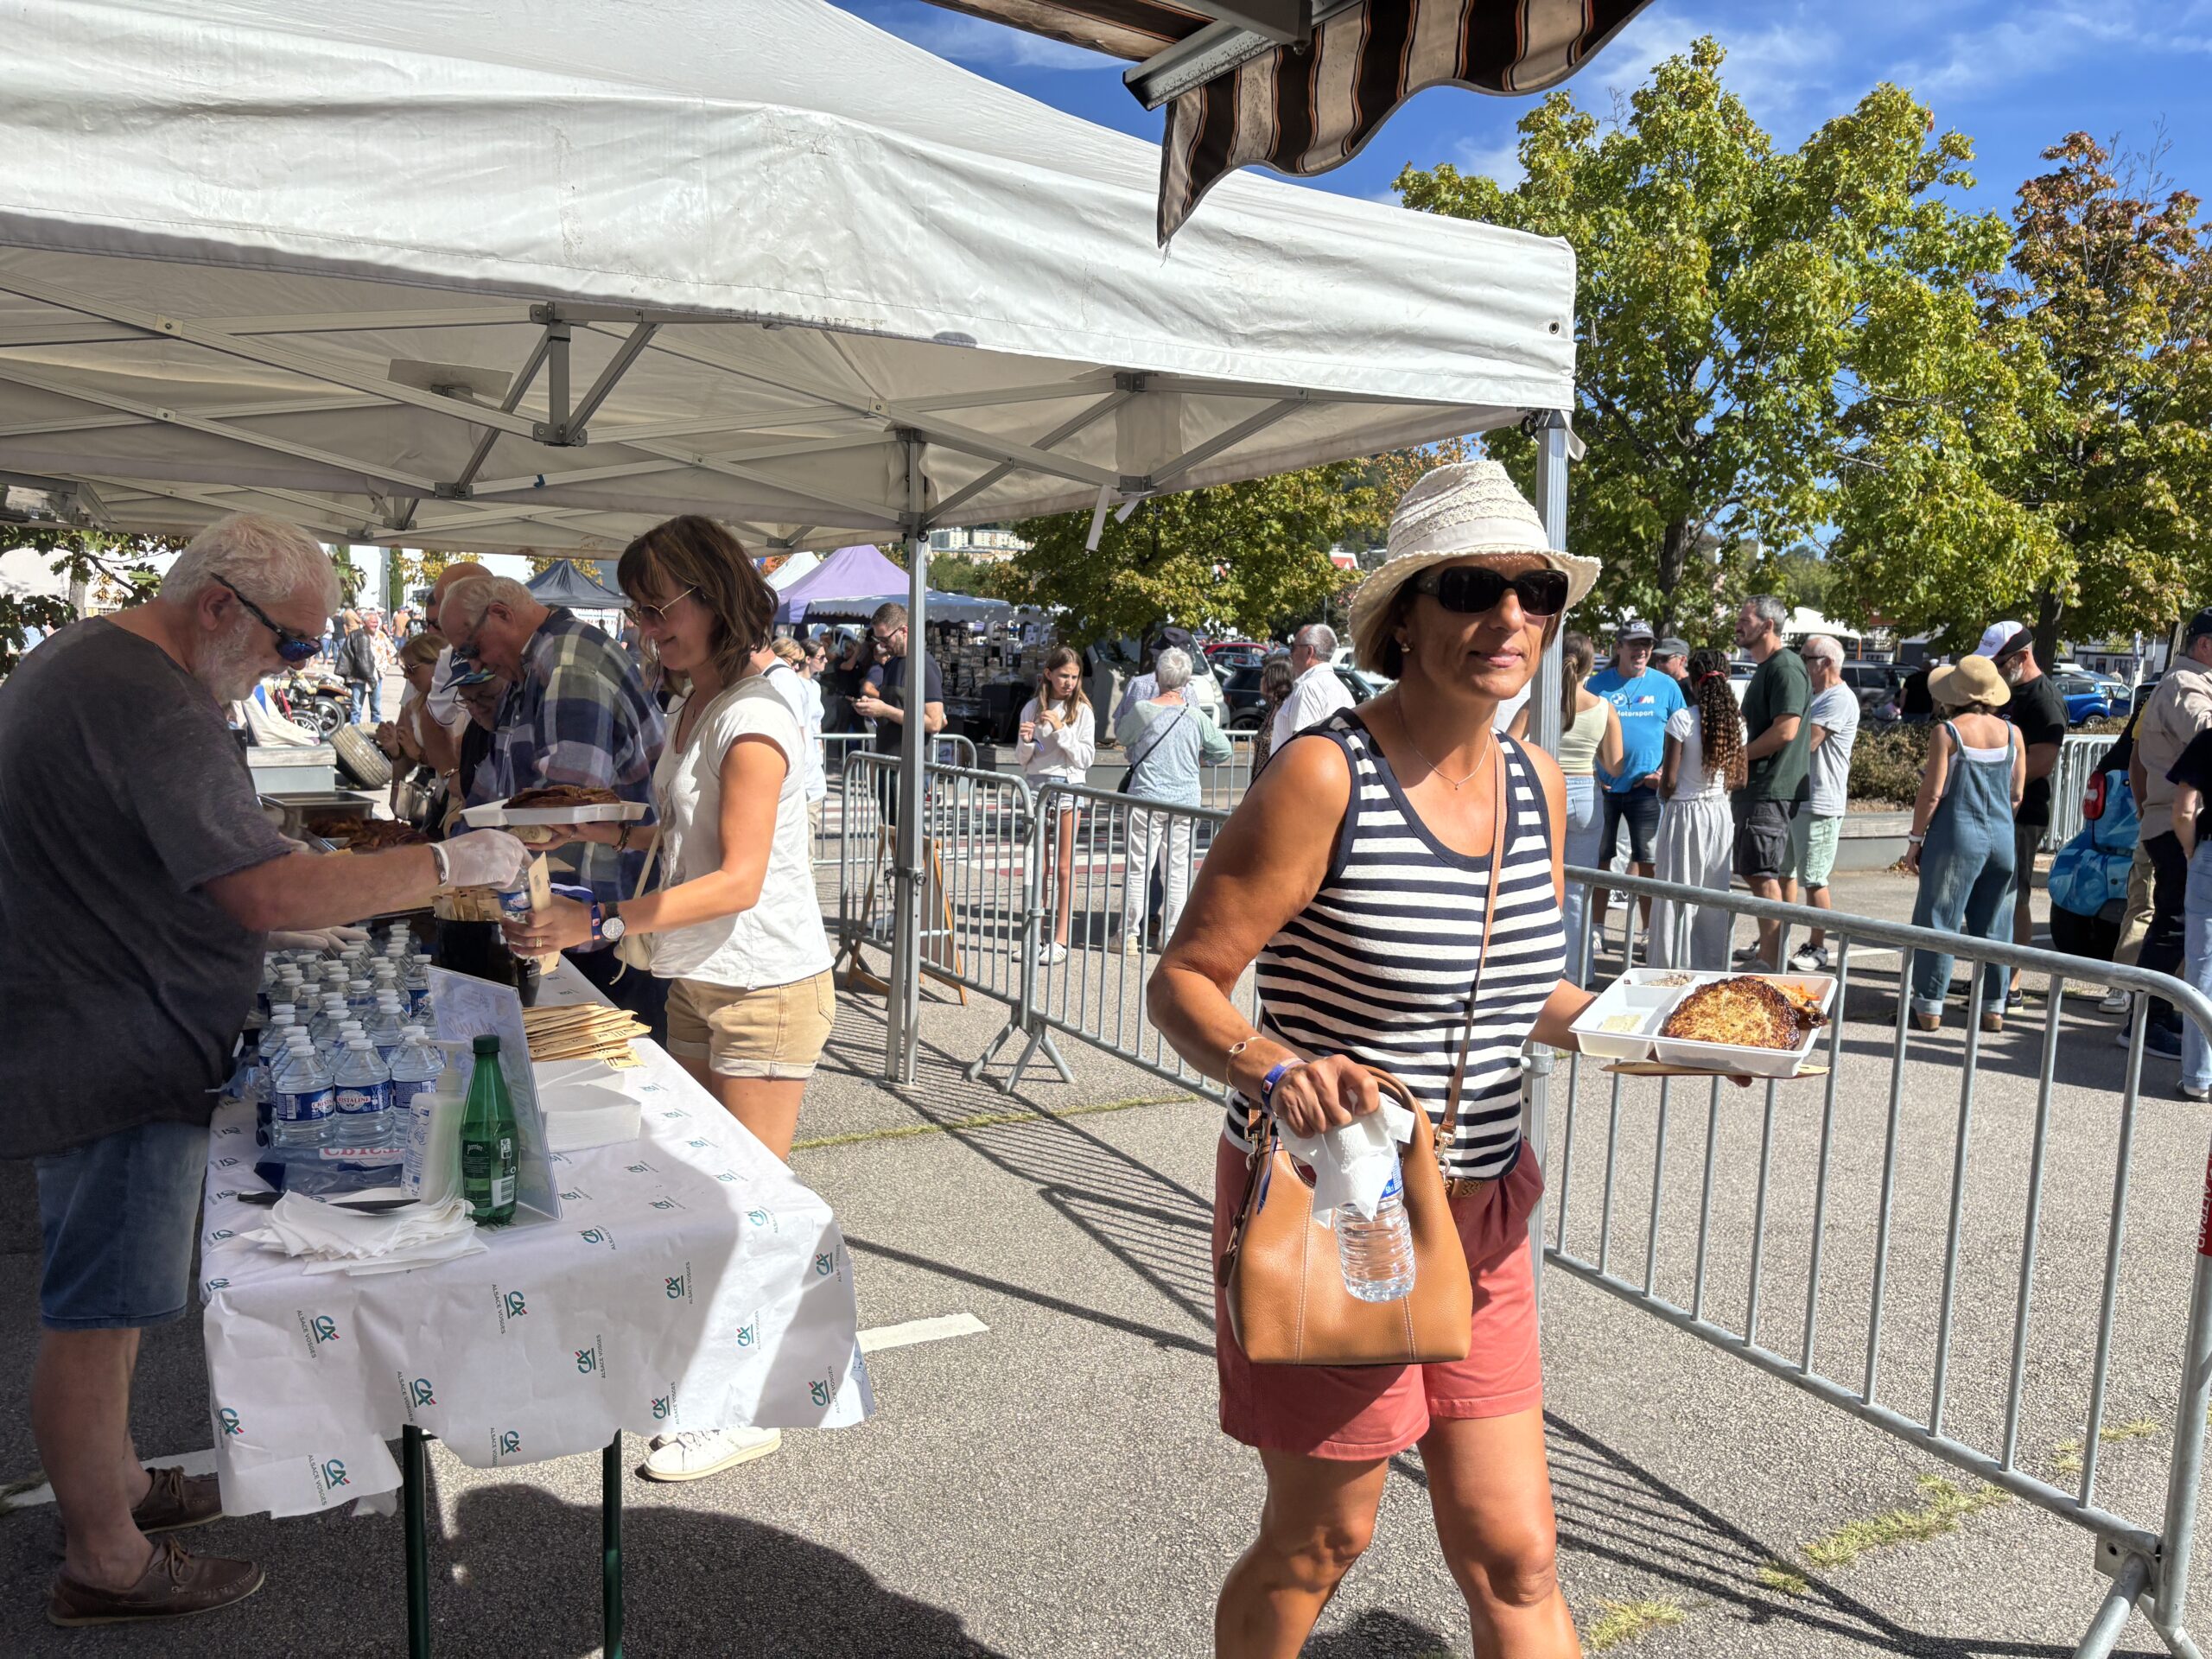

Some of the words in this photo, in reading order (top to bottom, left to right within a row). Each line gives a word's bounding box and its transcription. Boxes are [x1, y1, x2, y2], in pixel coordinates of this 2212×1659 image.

[492, 1284, 502, 1309] ALSACE
[297, 1310, 308, 1333] ALSACE
[305, 1333, 316, 1358] VOSGES
[397, 1370, 407, 1395] ALSACE
[308, 1454, 319, 1479] ALSACE
[315, 1480, 327, 1506] VOSGES
